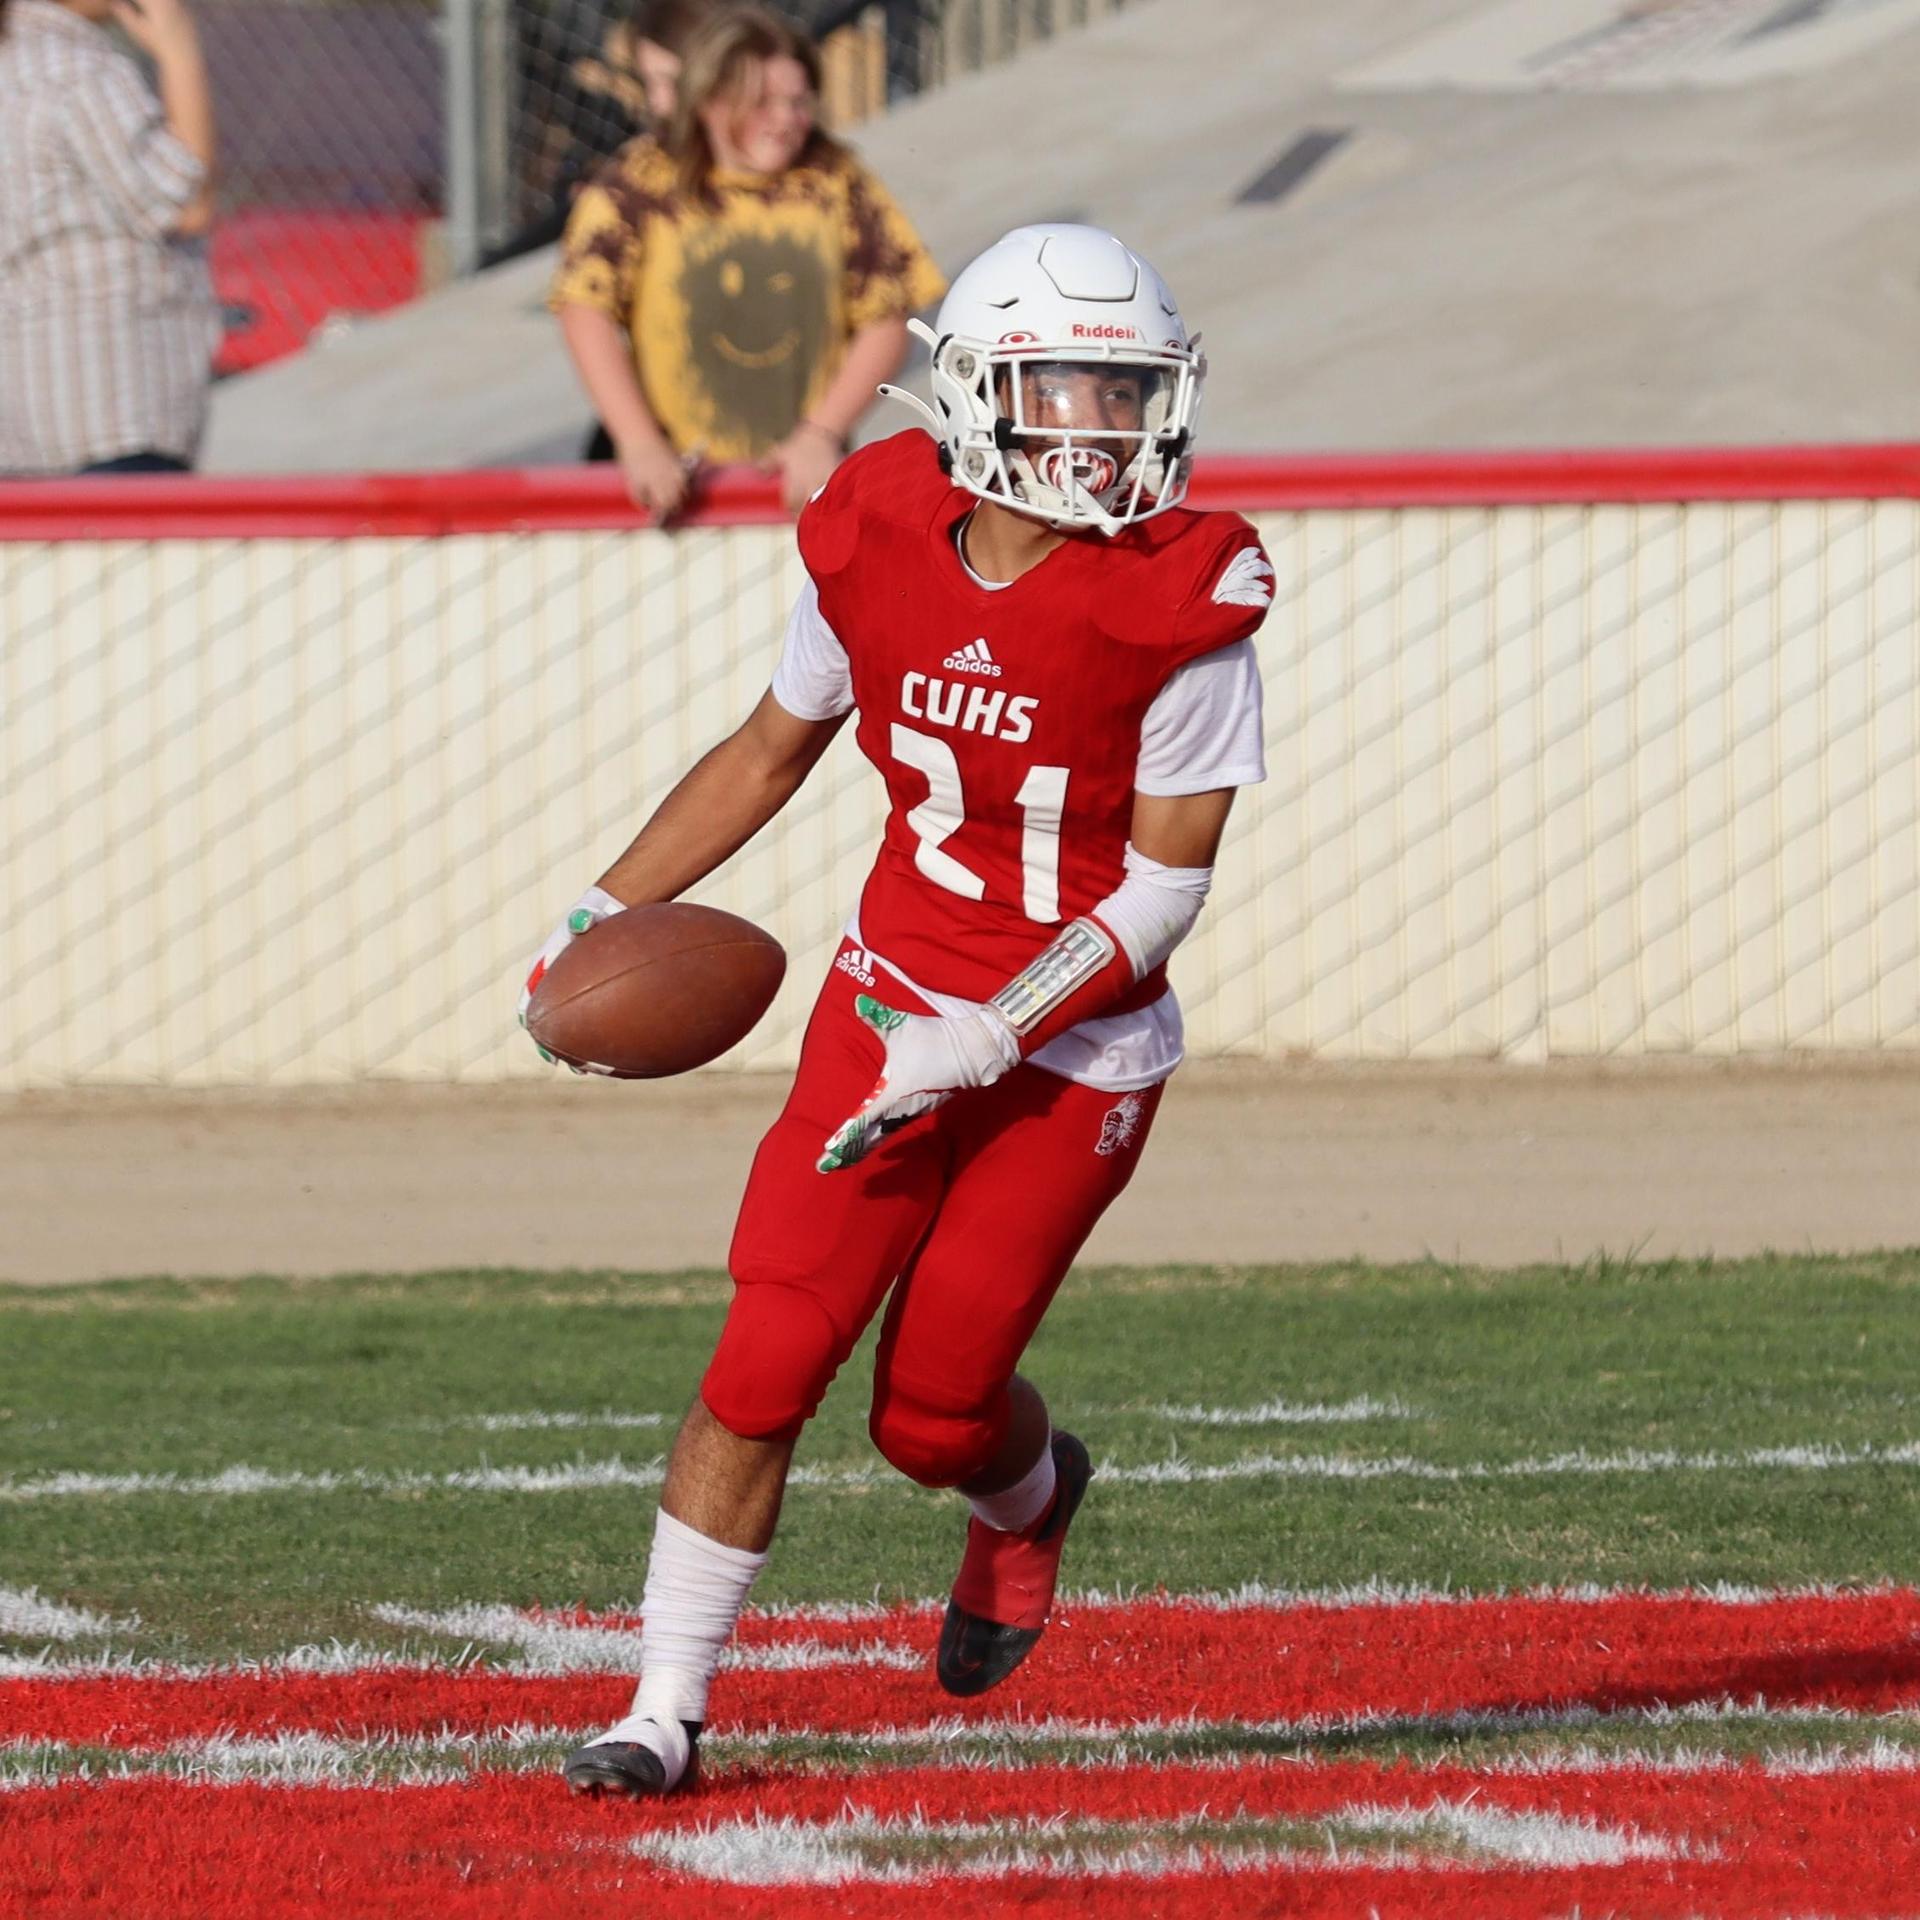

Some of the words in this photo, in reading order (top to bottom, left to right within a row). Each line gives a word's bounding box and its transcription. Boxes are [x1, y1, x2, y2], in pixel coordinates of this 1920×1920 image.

[943, 656, 1002, 677] adidas
[901, 670, 1039, 743] CUHS
[890, 721, 1070, 924] 21
[835, 956, 876, 988] adidas
